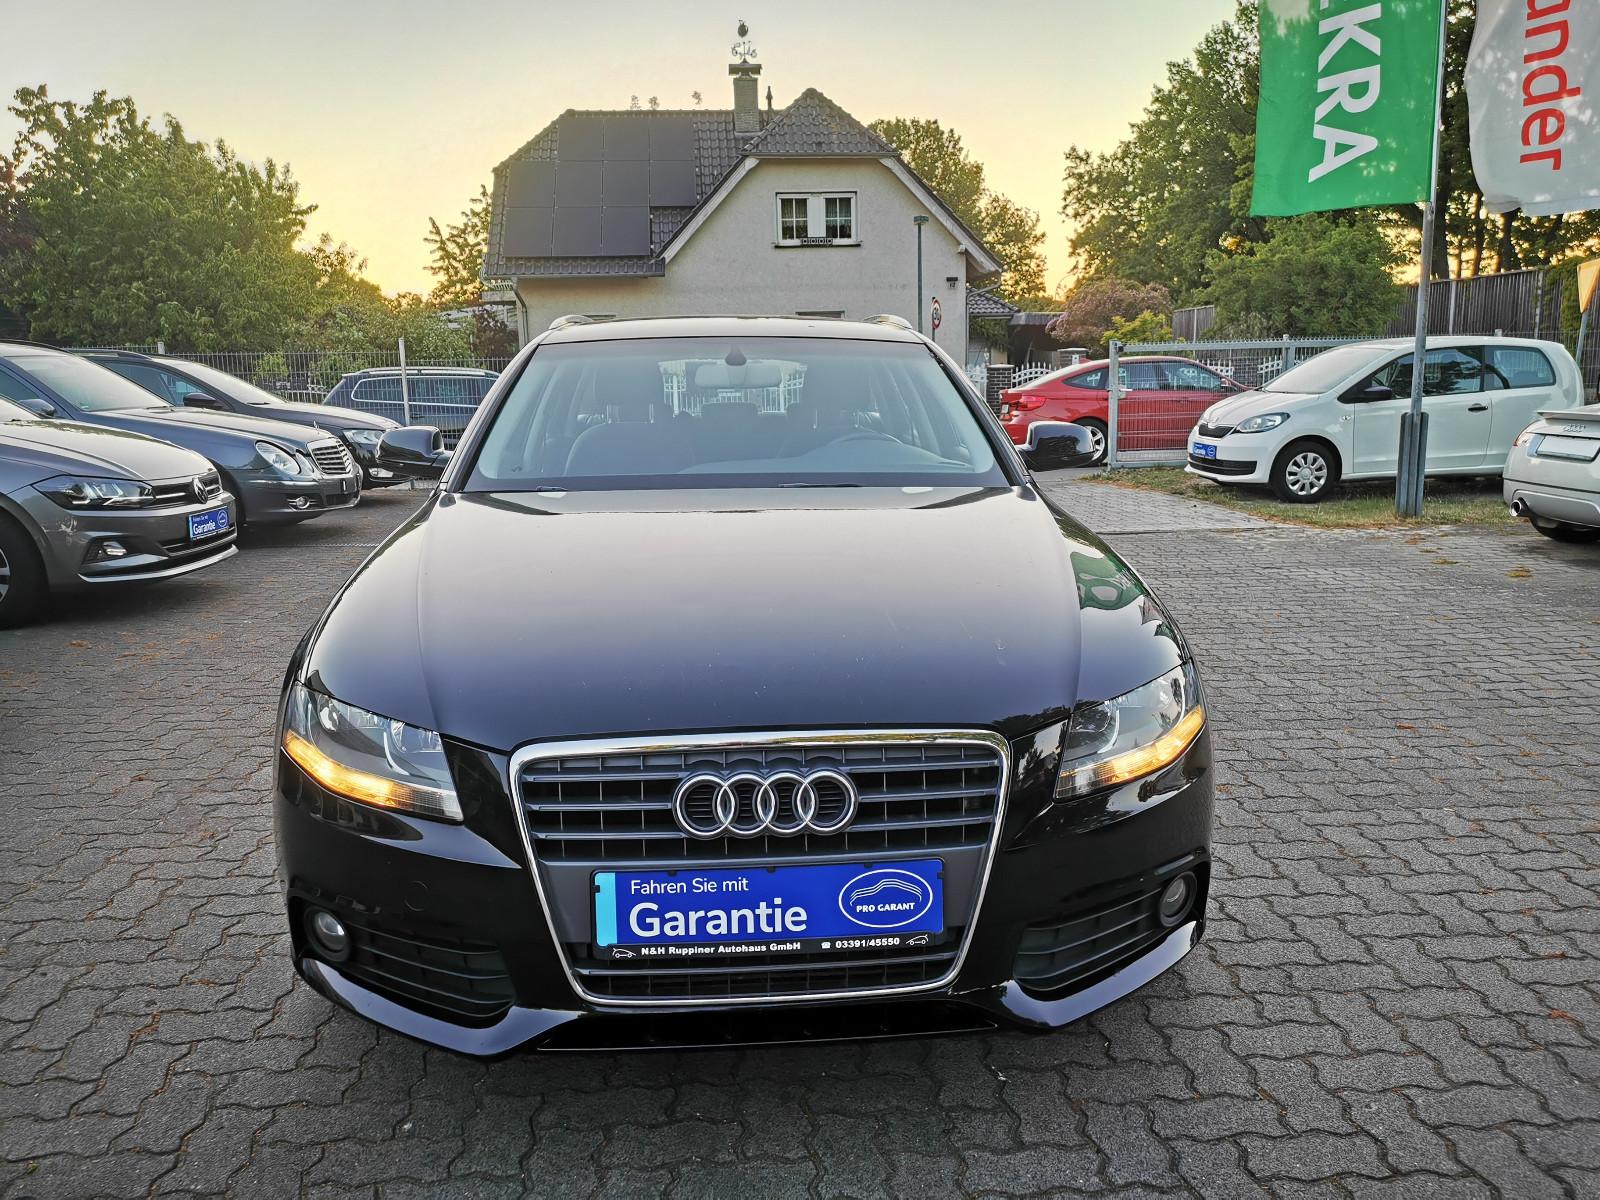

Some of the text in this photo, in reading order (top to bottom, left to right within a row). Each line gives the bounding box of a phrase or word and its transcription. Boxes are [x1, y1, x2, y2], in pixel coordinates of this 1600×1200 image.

[1308, 0, 1382, 183] KRA
[193, 520, 216, 534] Garantie
[631, 877, 749, 894] Fahren Sie mit
[877, 903, 915, 911] GARANT
[629, 897, 808, 937] Garantie
[641, 942, 801, 956] N&H Ruppiner Autohaus GmbH
[835, 938, 900, 948] 03391/45550
